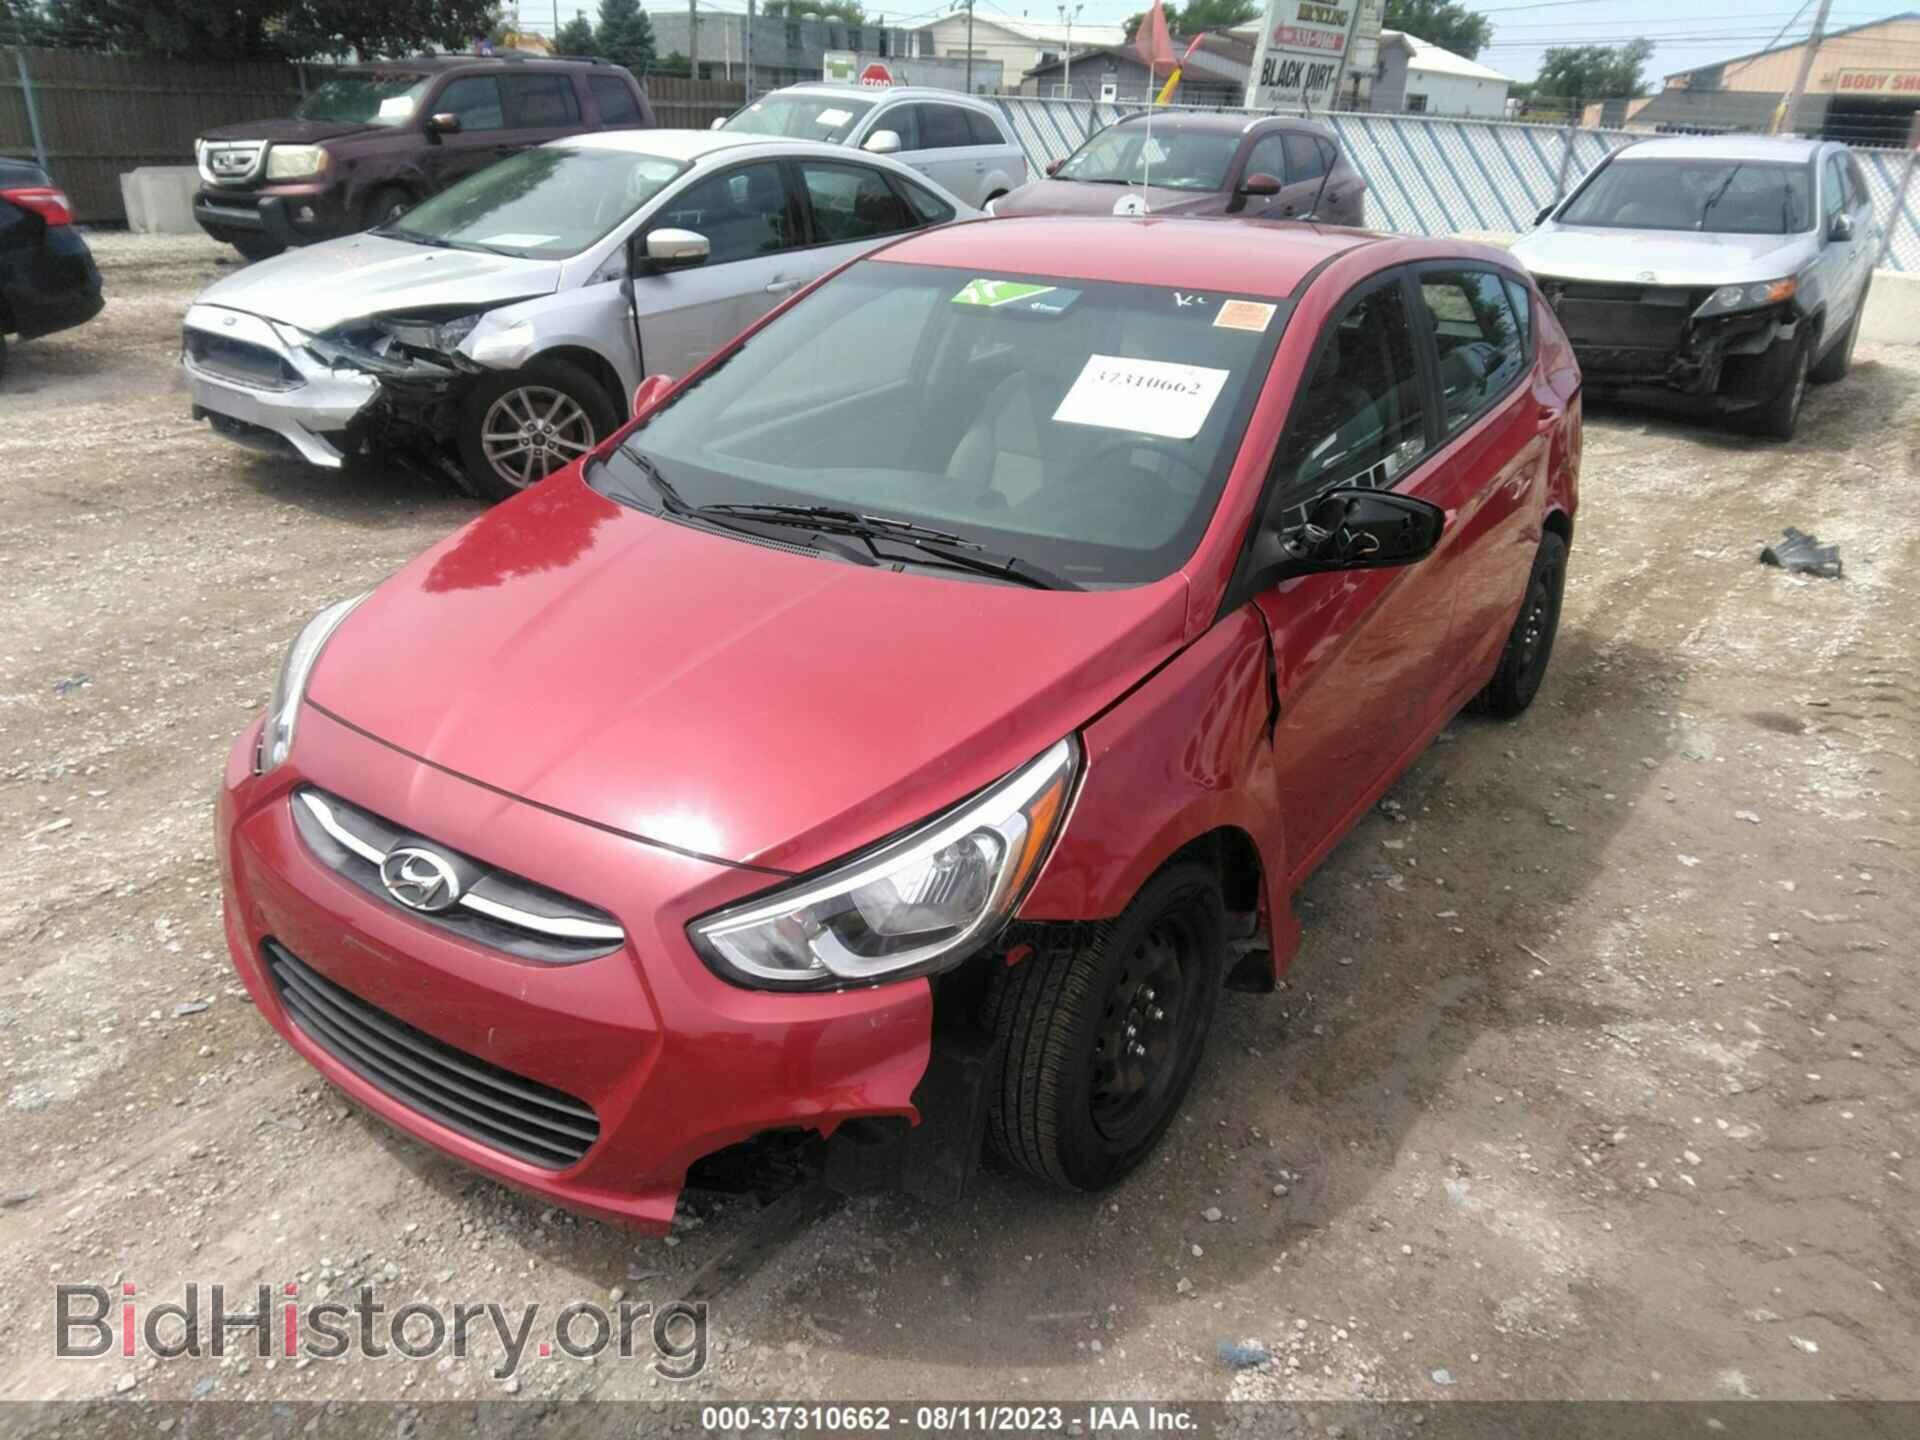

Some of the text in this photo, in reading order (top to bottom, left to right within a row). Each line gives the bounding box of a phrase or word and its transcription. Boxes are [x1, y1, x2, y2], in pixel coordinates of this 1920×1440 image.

[863, 78, 890, 89] STOP
[1260, 58, 1335, 91] BLACK DIRT
[1840, 74, 1888, 89] BODY
[1099, 371, 1202, 396] 37310662
